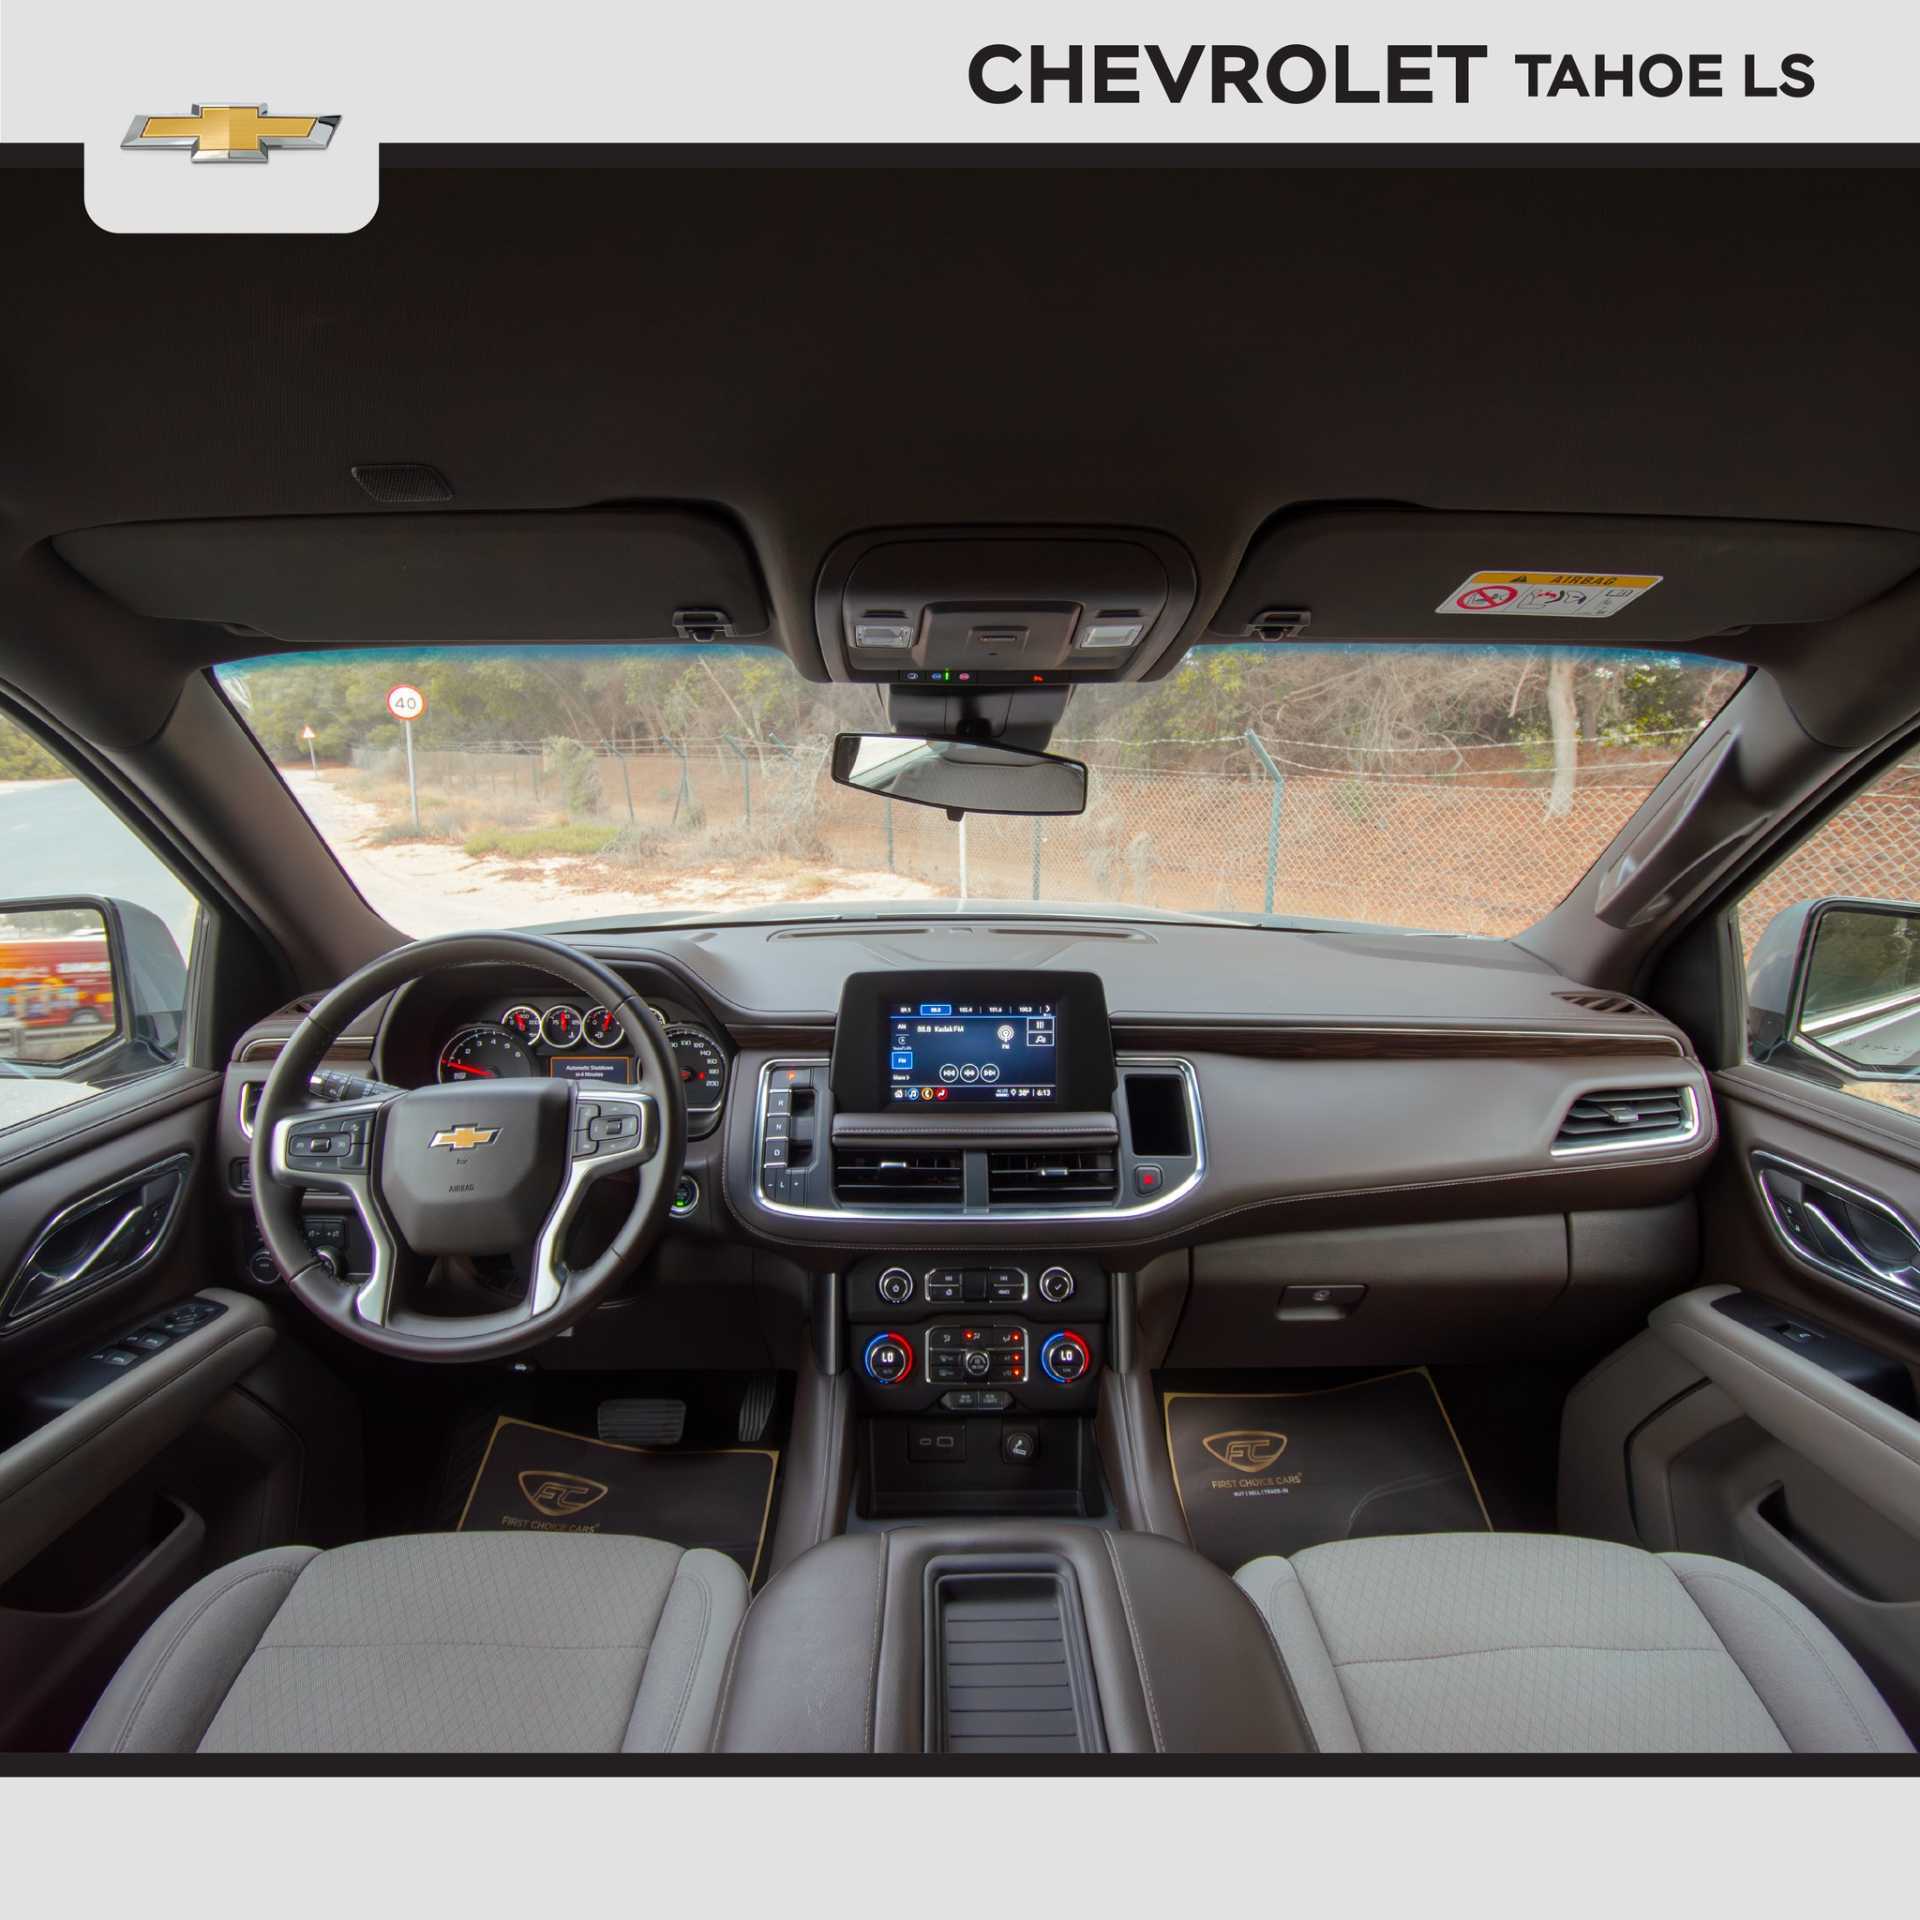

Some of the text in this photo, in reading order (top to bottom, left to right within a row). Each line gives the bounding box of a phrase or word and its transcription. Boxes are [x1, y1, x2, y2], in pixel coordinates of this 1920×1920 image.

[1550, 576, 1618, 586] AIRBAG
[394, 696, 417, 710] 40
[448, 1184, 475, 1193] AIRBAG
[1211, 1475, 1301, 1489] FIRST CHOICE CARS
[501, 1515, 595, 1534] FIRST CHOICE CARS
